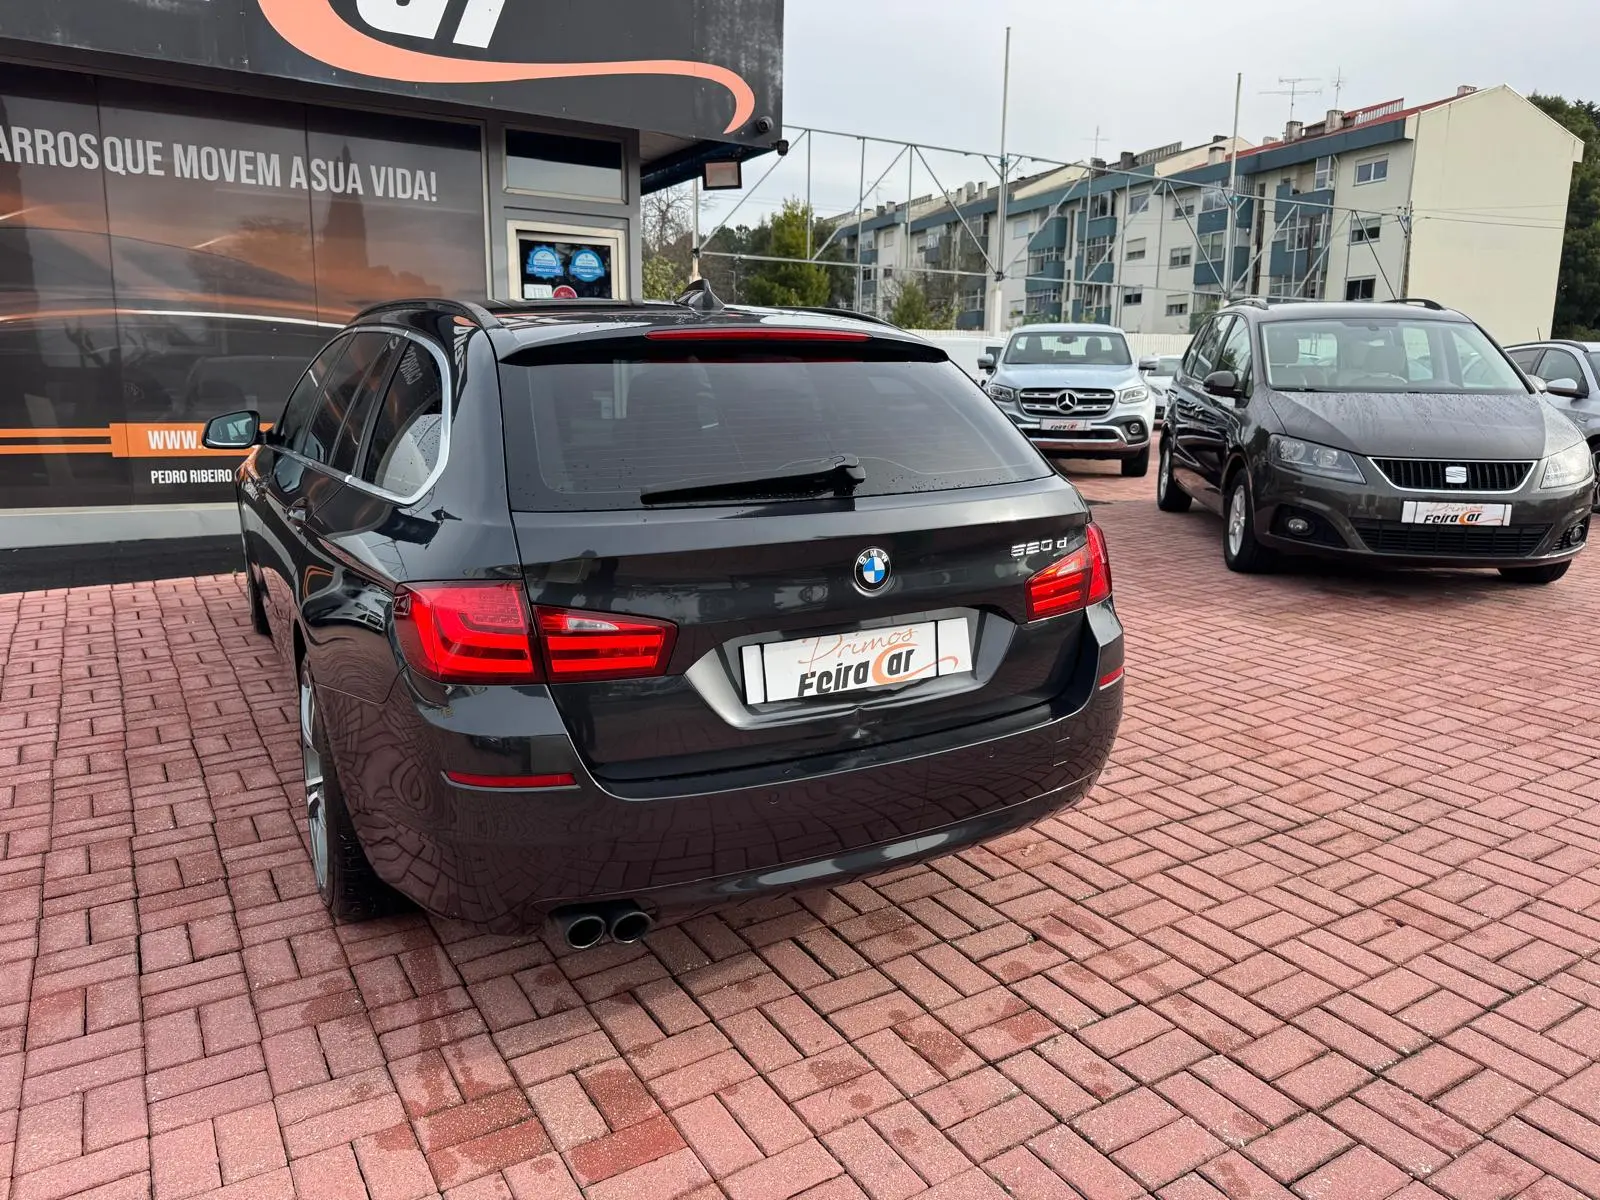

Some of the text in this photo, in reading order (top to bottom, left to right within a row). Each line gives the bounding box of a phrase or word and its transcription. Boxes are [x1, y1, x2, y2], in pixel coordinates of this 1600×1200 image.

[103, 136, 165, 176] QUE
[172, 143, 281, 187] MOVEM
[370, 165, 438, 202] VIDA!
[147, 430, 206, 450] WWW.
[151, 468, 233, 484] PEDRO RIBEIRO
[858, 549, 889, 566] BMW
[798, 627, 918, 676] Primos
